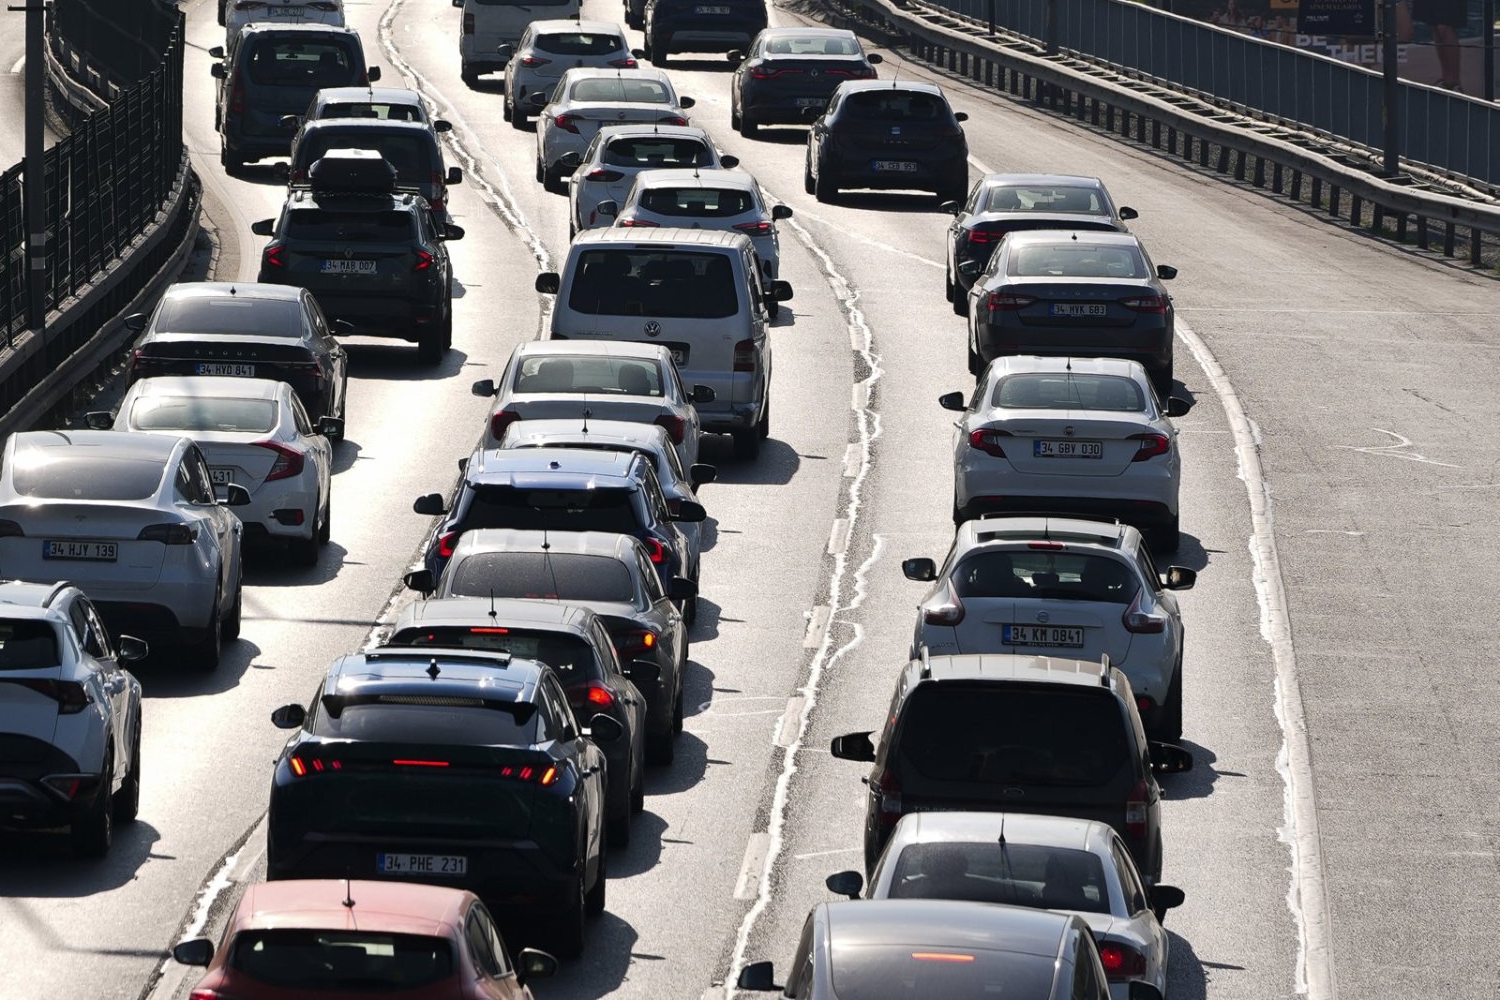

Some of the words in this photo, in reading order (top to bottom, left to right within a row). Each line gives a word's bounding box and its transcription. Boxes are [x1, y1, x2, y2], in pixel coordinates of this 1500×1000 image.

[327, 260, 337, 269] 34
[340, 260, 356, 270] MAB
[359, 261, 374, 271] 007
[1054, 304, 1065, 313] 34
[1088, 305, 1105, 315] 683
[200, 365, 211, 374] 34
[235, 366, 253, 376] 841
[1041, 442, 1053, 453] 34
[1058, 442, 1076, 454] GBV
[1081, 443, 1100, 455] 030
[51, 543, 64, 555] 34
[68, 543, 88, 556] HJY
[96, 545, 115, 557] 139
[1012, 627, 1027, 640] 34
[1032, 628, 1047, 641] KM
[1052, 629, 1081, 643] 0841
[386, 855, 400, 870] 34
[409, 856, 433, 871] PHE
[441, 858, 464, 872] 231
